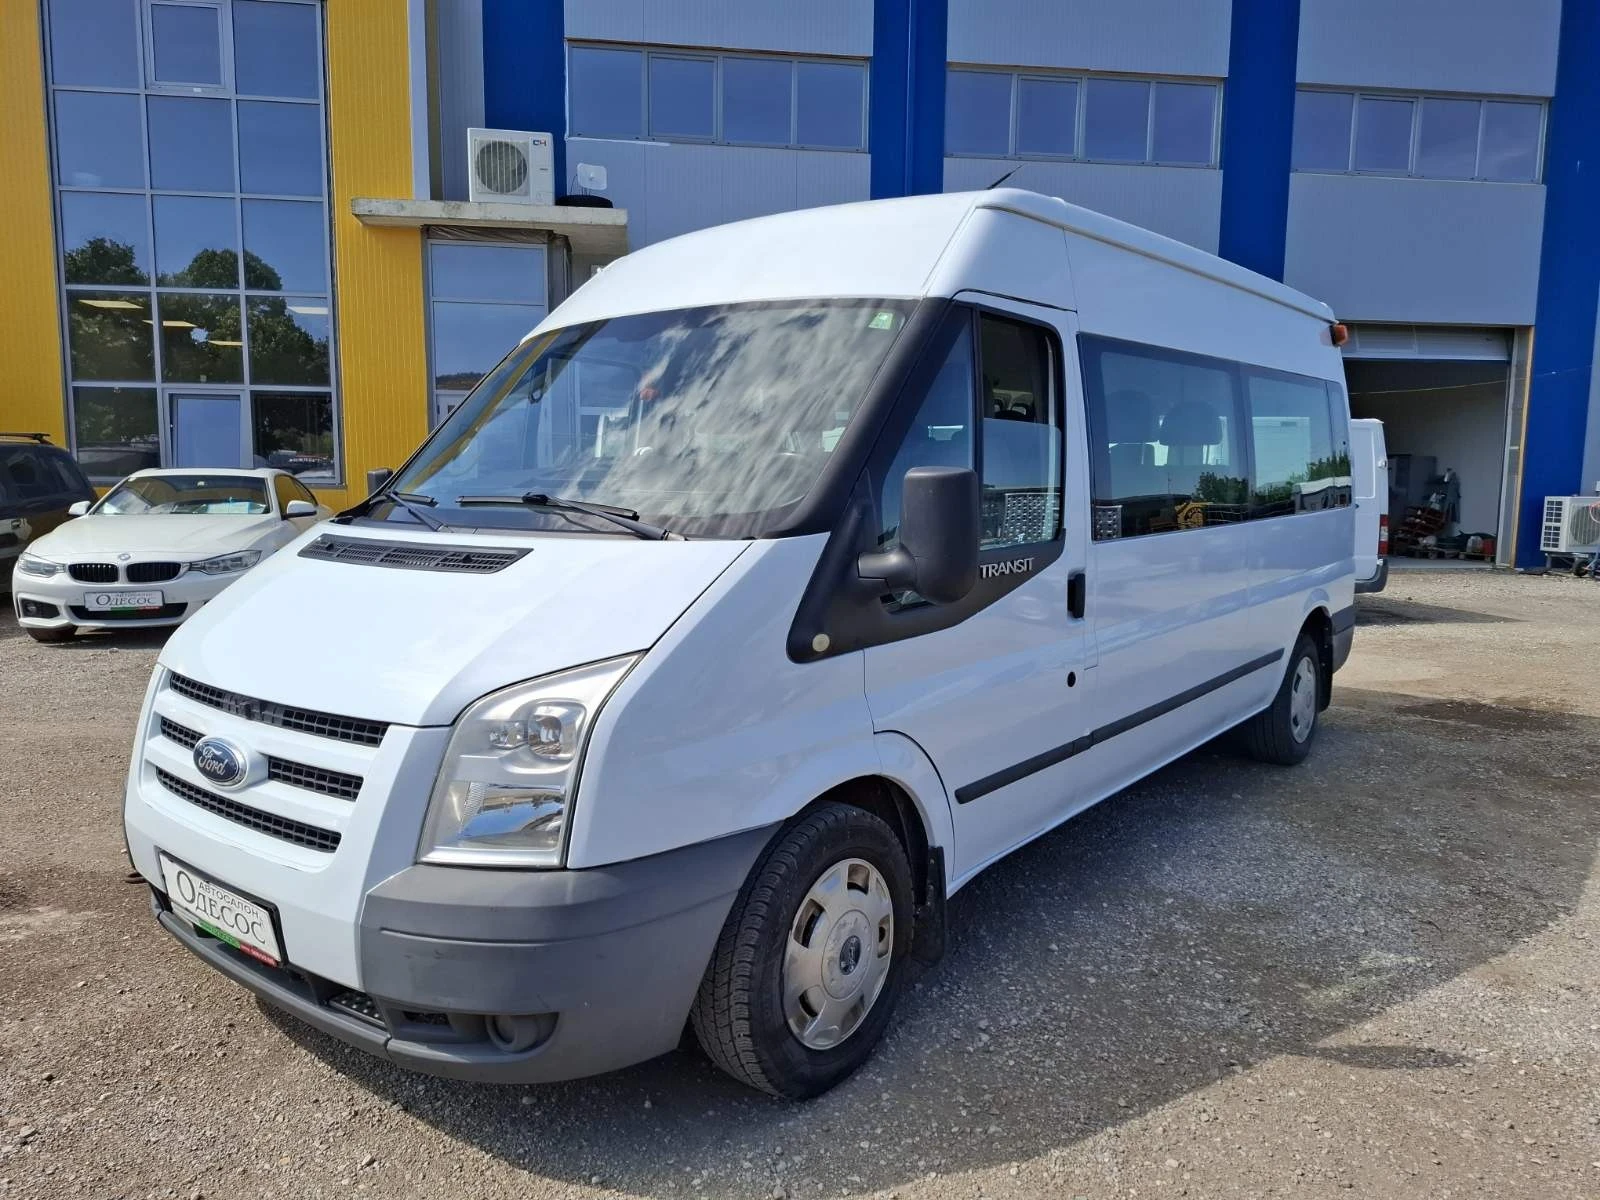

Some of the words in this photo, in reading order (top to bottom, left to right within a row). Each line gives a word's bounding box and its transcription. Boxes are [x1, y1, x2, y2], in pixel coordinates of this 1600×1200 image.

[980, 557, 1034, 578] TRANSIT
[198, 746, 229, 775] Ford
[199, 881, 260, 919] АВТОСАЛОН
